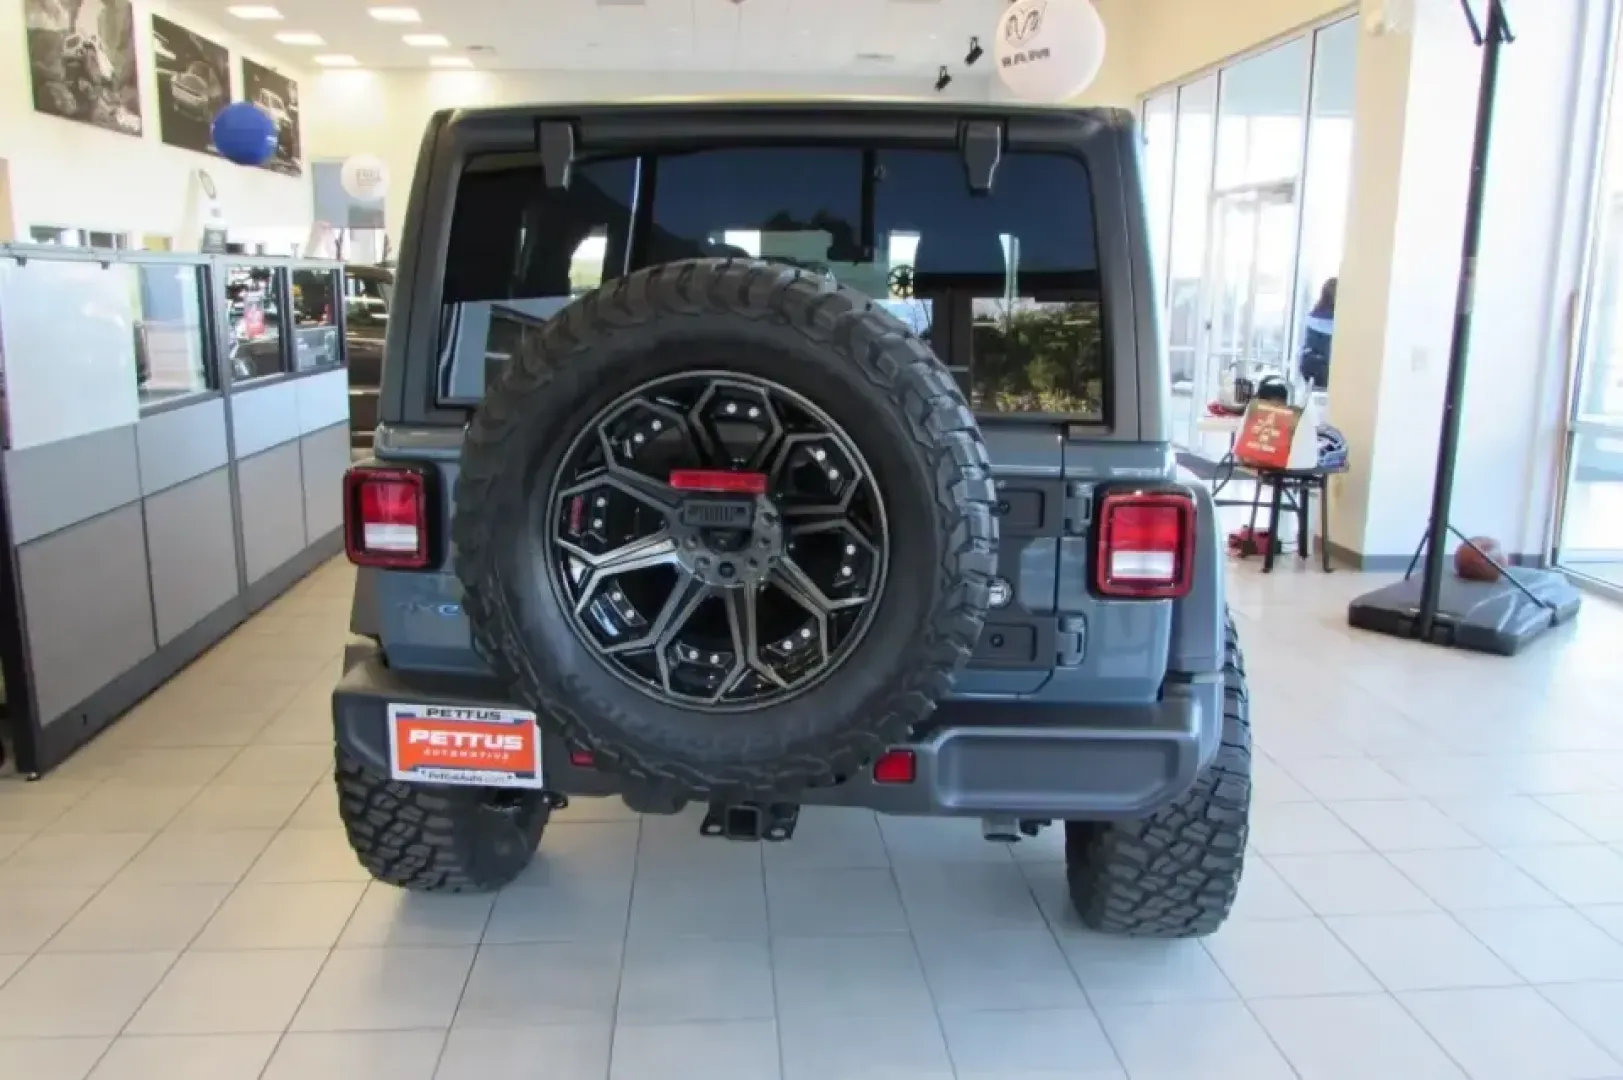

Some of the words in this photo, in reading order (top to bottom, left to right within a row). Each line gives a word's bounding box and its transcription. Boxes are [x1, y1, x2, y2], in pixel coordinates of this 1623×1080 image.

[426, 707, 501, 721] PETTUS
[408, 729, 524, 751] PETTUS
[423, 747, 510, 761] AUTOMOTIVE
